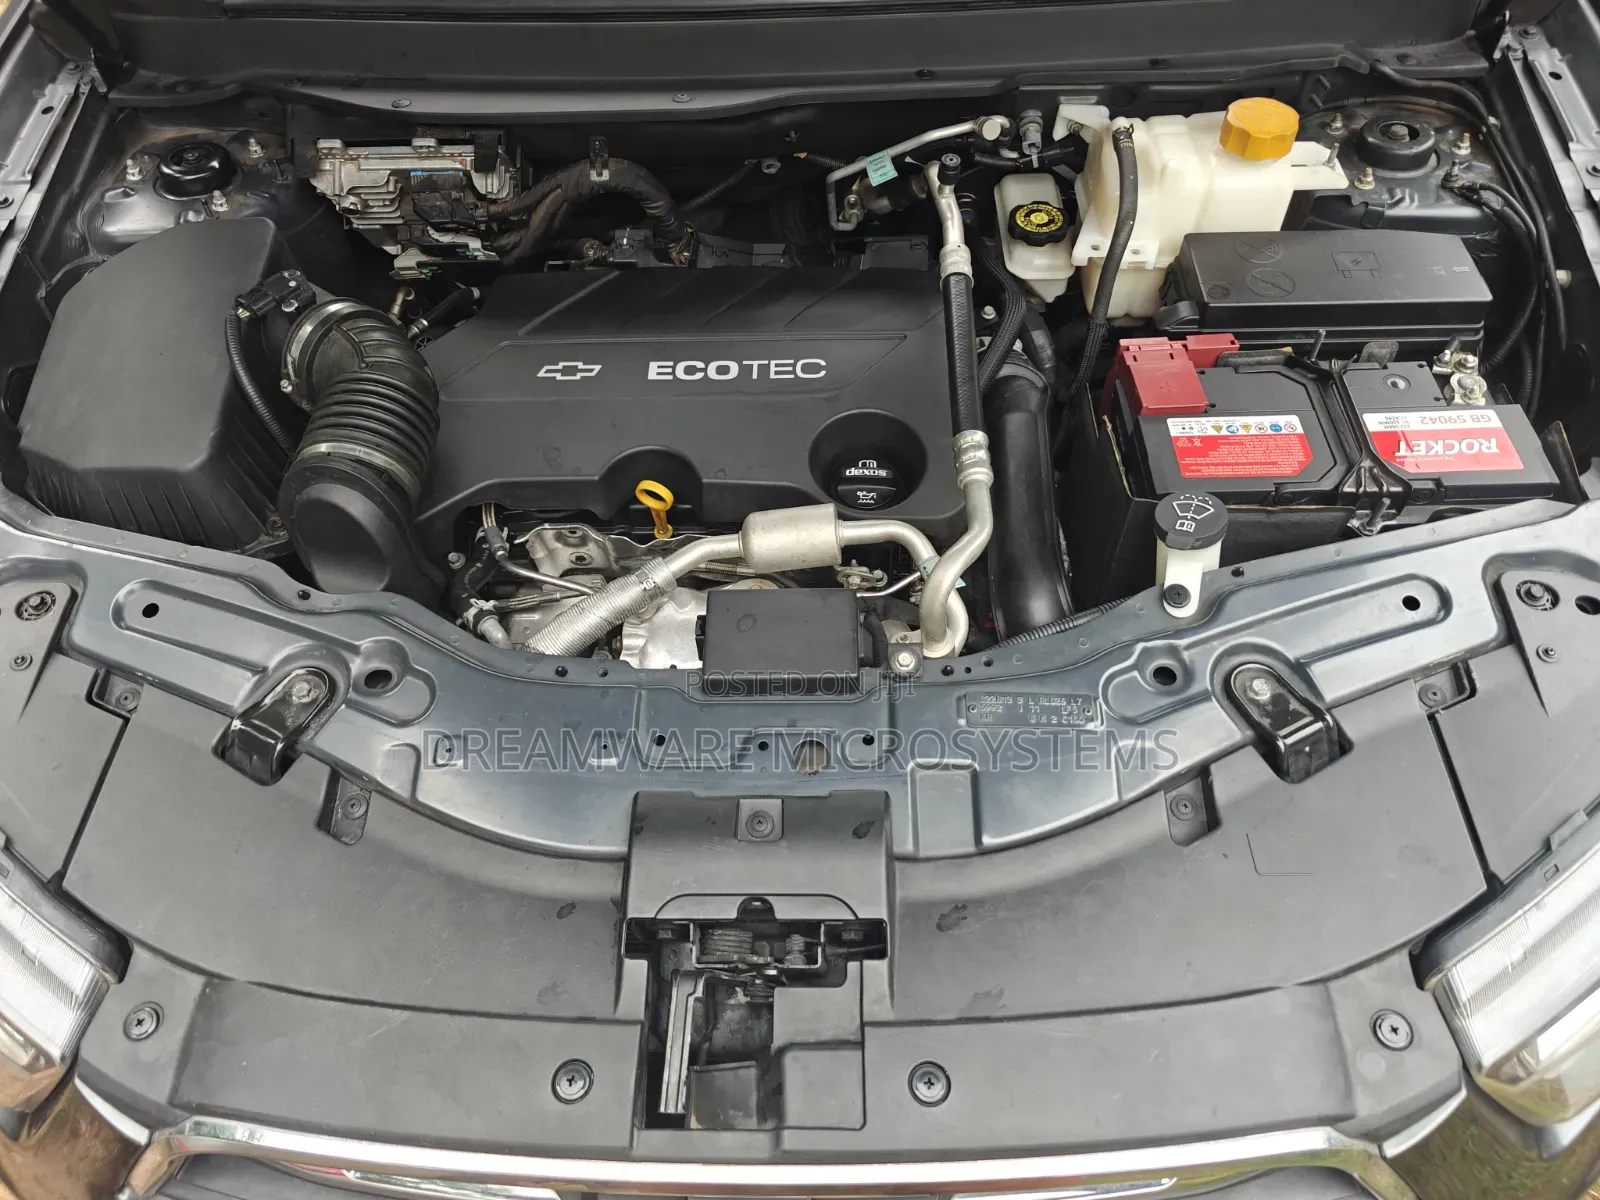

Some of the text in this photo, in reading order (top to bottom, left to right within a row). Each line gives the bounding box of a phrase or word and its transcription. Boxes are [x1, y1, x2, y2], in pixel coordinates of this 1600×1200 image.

[647, 358, 827, 380] ECOTEC
[1419, 413, 1491, 425] GB 59042
[1394, 437, 1500, 456] ROCKET
[845, 467, 888, 477] dexos
